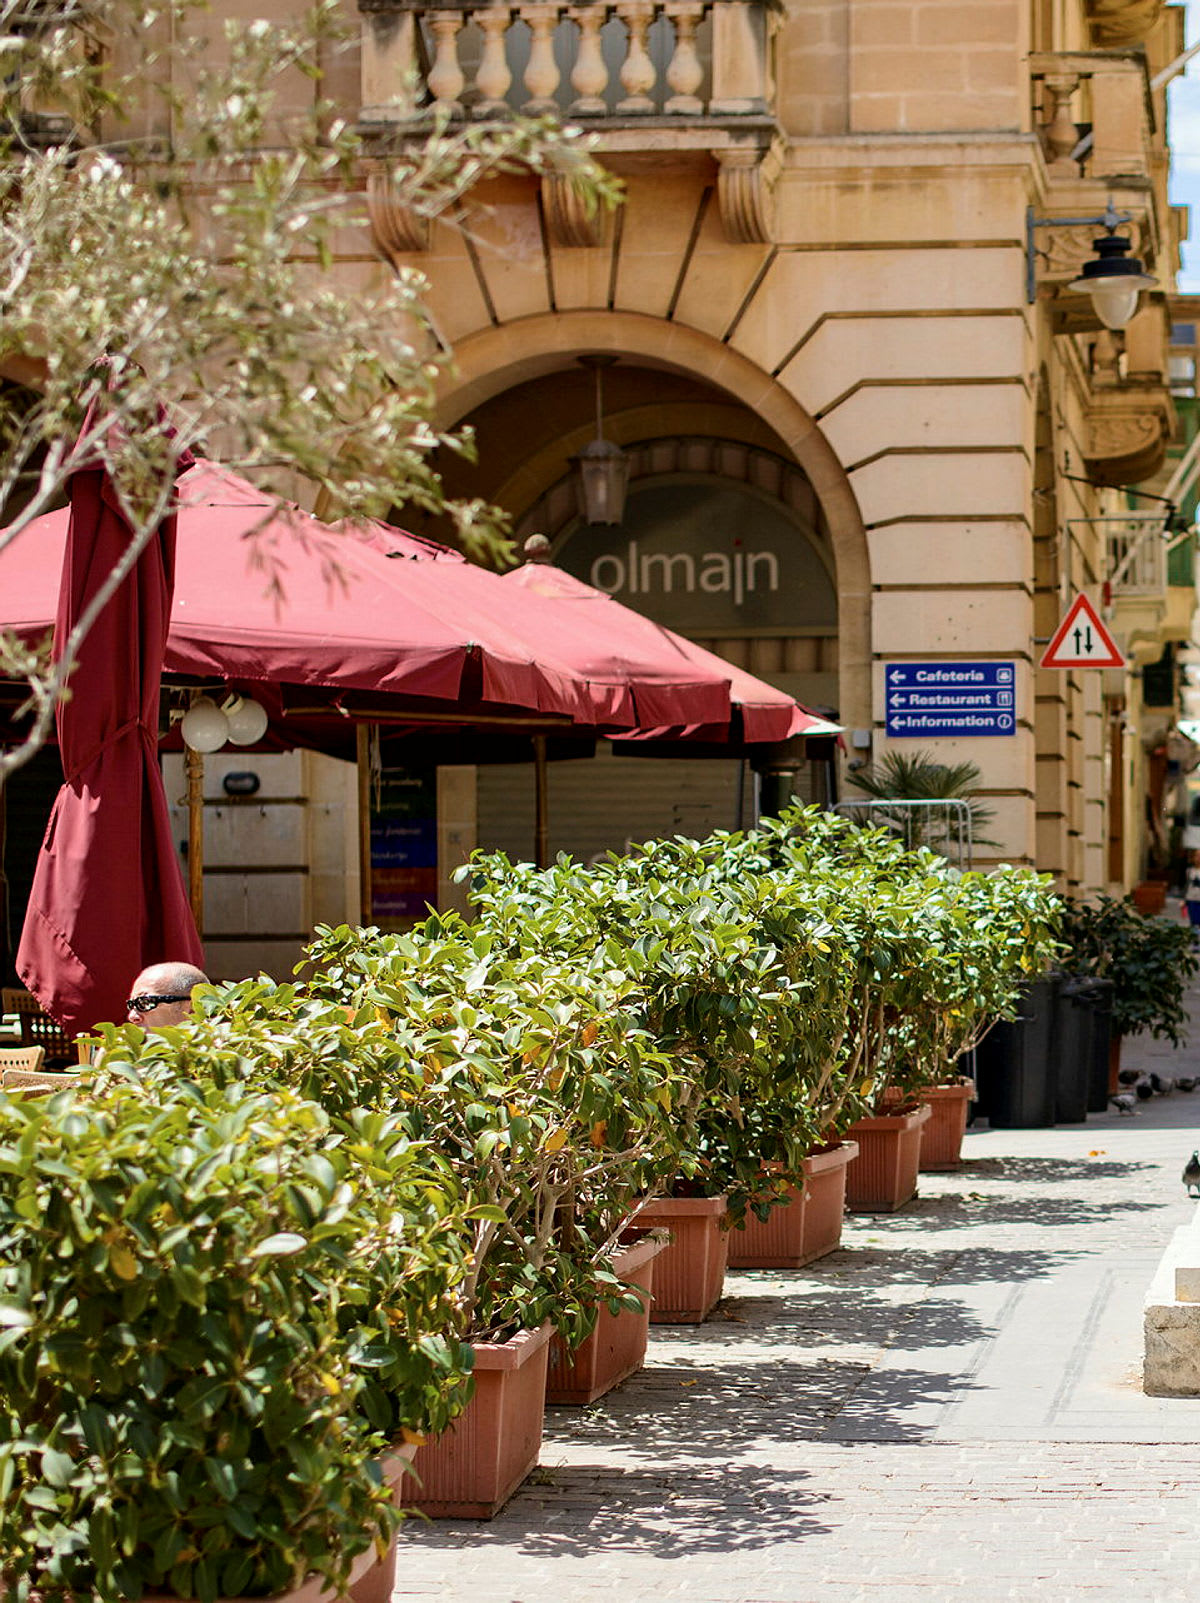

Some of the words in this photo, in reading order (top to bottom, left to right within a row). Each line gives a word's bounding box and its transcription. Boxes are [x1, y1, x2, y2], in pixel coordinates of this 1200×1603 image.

[916, 670, 985, 682] Cafeteria
[909, 694, 992, 705] Restaurant
[907, 715, 995, 727] Information
